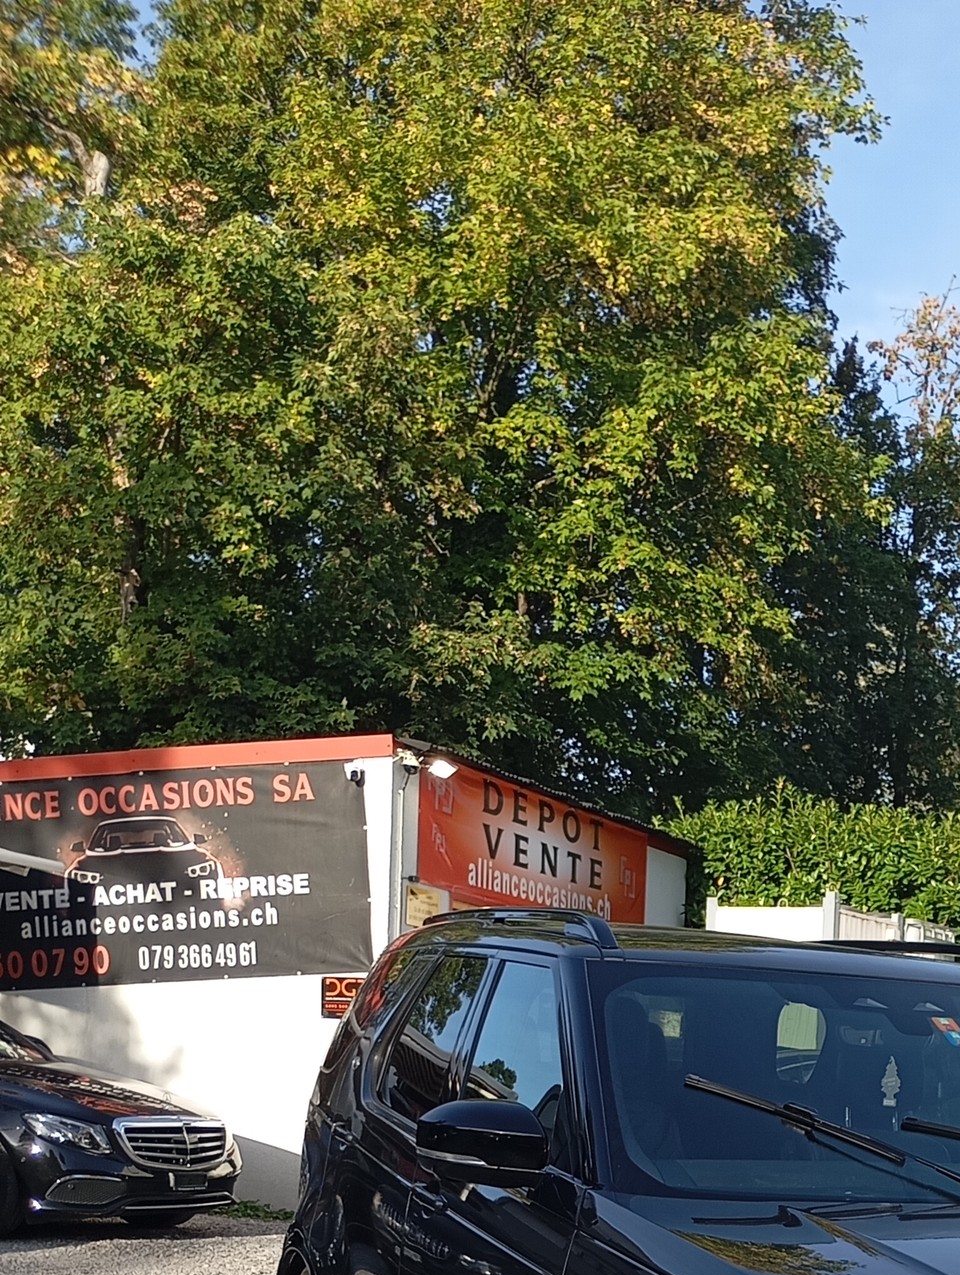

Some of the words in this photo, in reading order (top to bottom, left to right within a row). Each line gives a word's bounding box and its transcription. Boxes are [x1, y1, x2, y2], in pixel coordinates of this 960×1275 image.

[0, 790, 60, 821] NCE
[78, 776, 254, 816] OCCASIONS
[272, 772, 315, 803] SA
[482, 822, 603, 891] VENTE
[93, 881, 177, 907] ACHAT
[200, 873, 311, 900] REPRISE
[467, 857, 612, 921] allianceoccasions.ch
[20, 902, 279, 939] allianceoccasions.ch
[0, 950, 25, 979] 0
